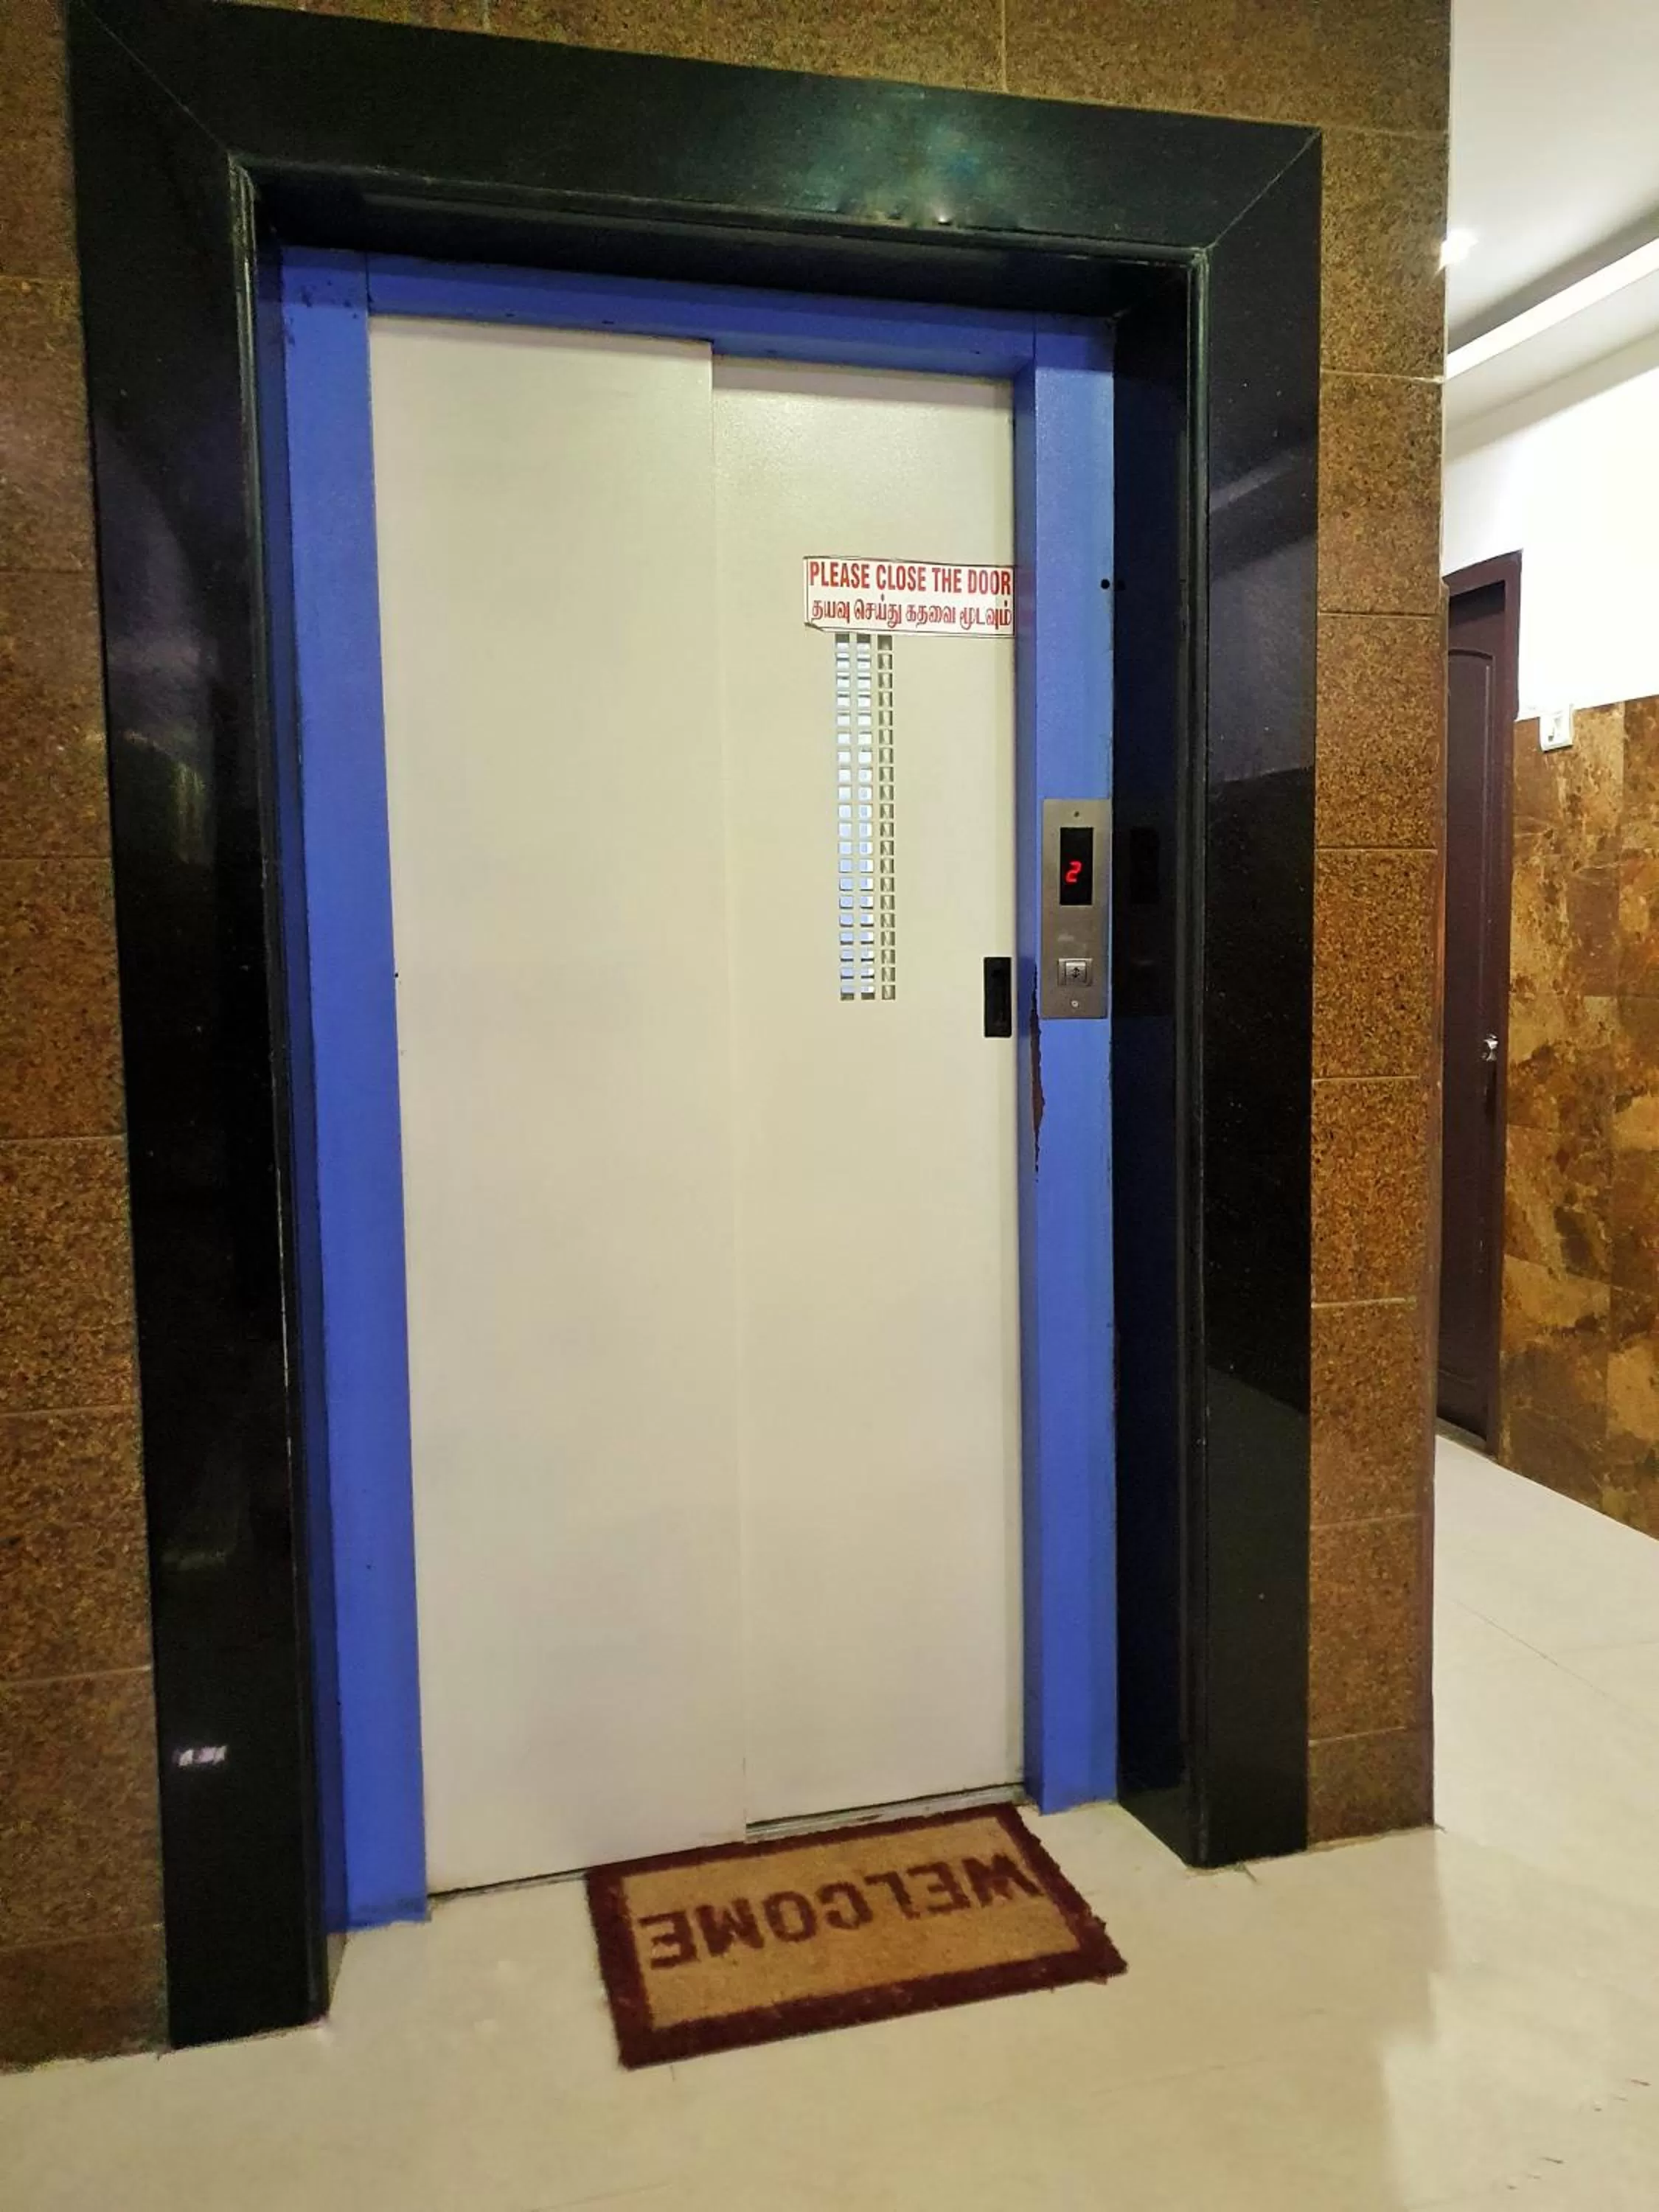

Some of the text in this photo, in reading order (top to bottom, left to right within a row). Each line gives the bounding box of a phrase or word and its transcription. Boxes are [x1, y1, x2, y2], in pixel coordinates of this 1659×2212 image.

[810, 561, 1011, 595] PLEASE CLOSE THE DOOR
[812, 593, 1012, 630] தயவு செய்து கதவை மூடவும்
[1065, 860, 1082, 883] 2
[638, 1852, 1043, 1970] WELCOME
